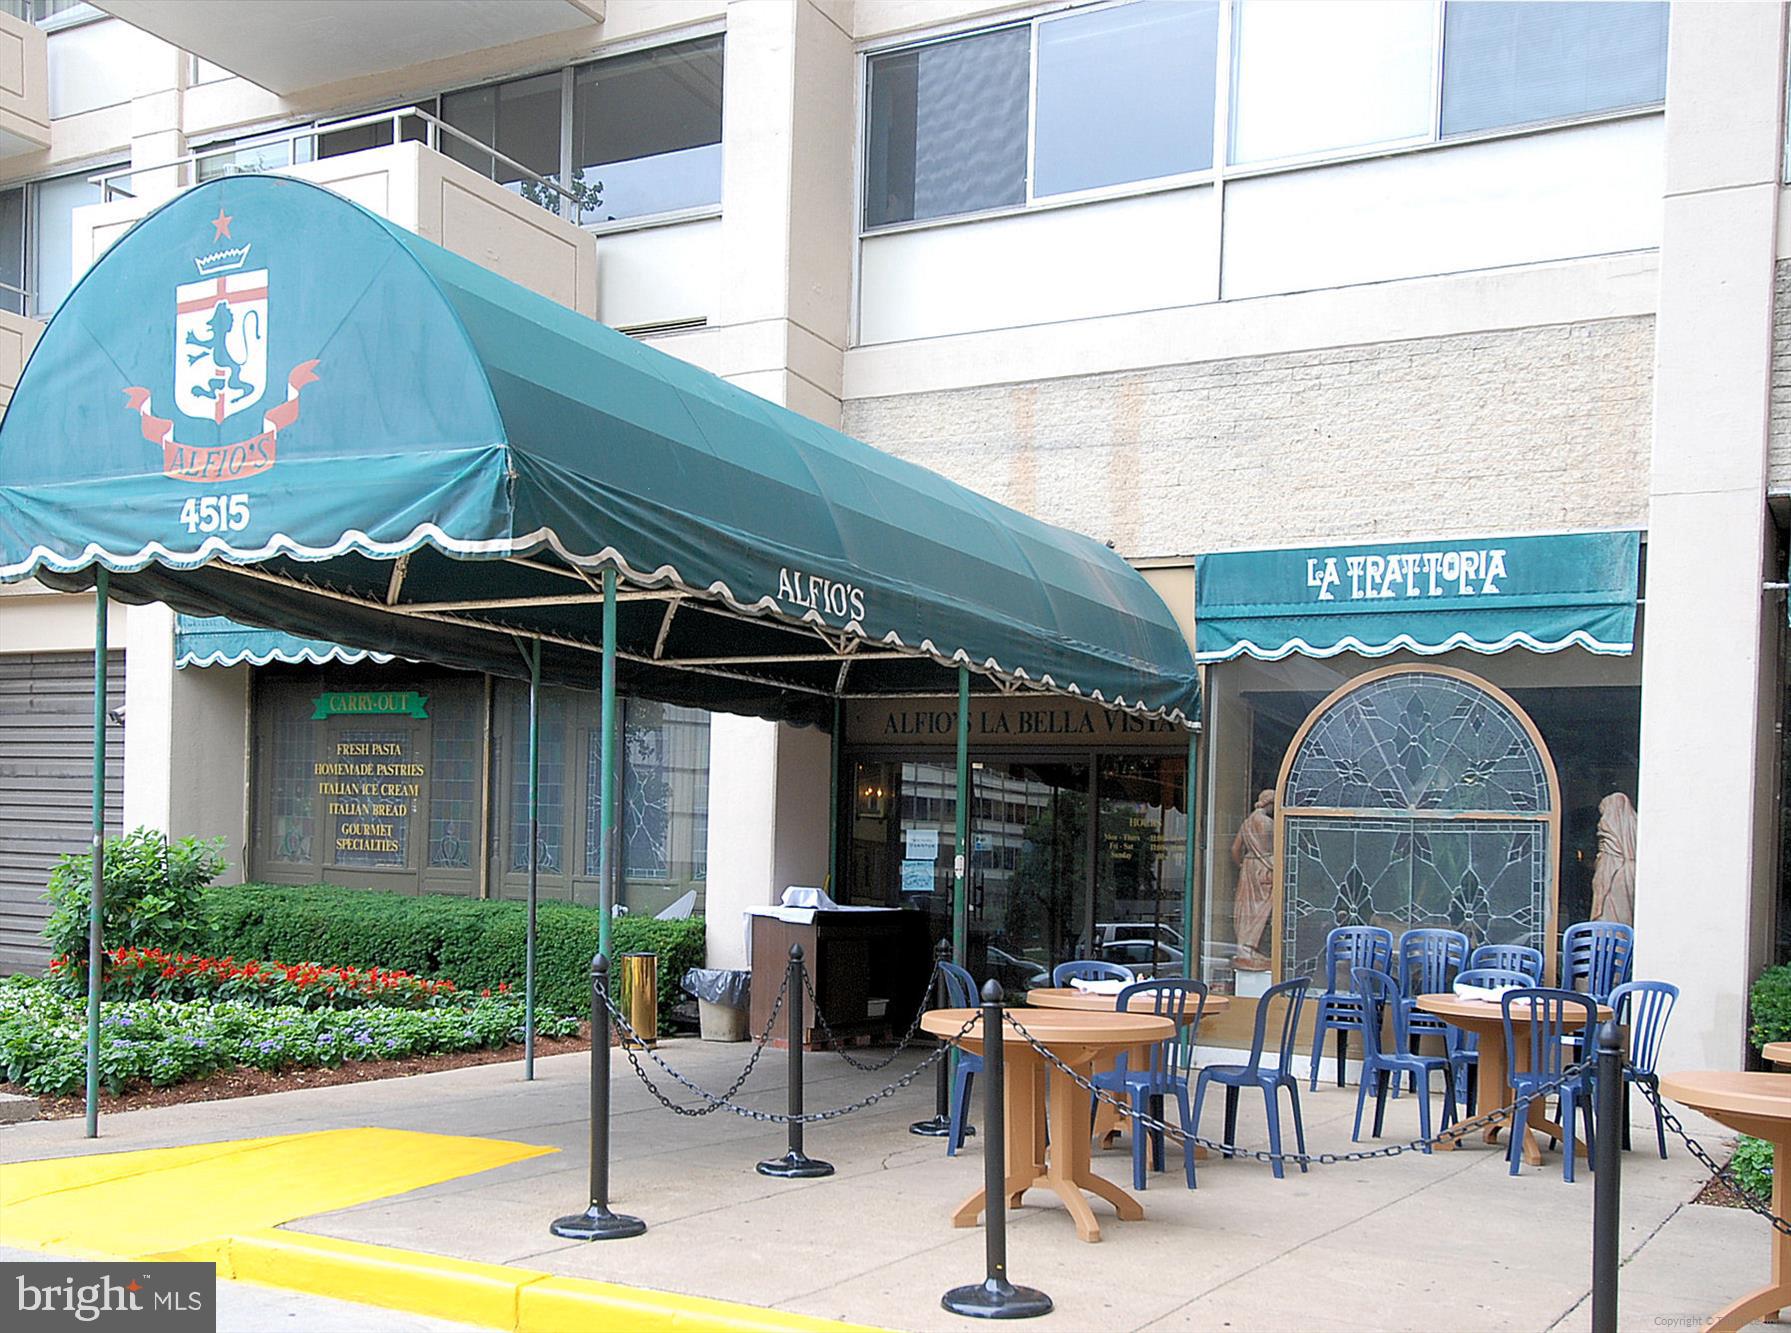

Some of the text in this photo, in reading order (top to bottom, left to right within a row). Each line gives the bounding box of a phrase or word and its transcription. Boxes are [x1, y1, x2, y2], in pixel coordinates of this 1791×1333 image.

[169, 437, 271, 478] ALFIO'S
[179, 493, 251, 534] 4515
[1307, 549, 1508, 600] LA TRATTORIA
[777, 568, 865, 621] ALFIO'S
[329, 694, 409, 711] CARRY-OUT
[981, 711, 1010, 733] LA
[1019, 710, 1094, 733] BELLA
[336, 743, 401, 755] FRESH PASTA
[314, 763, 425, 776] HOMEMADE PASTRIES
[319, 782, 419, 796] ITALIAN ICE CREAM
[329, 802, 407, 817] ITALIAN BREAD
[341, 823, 393, 837] GOURMET
[336, 838, 399, 852] SPECIALTIES
